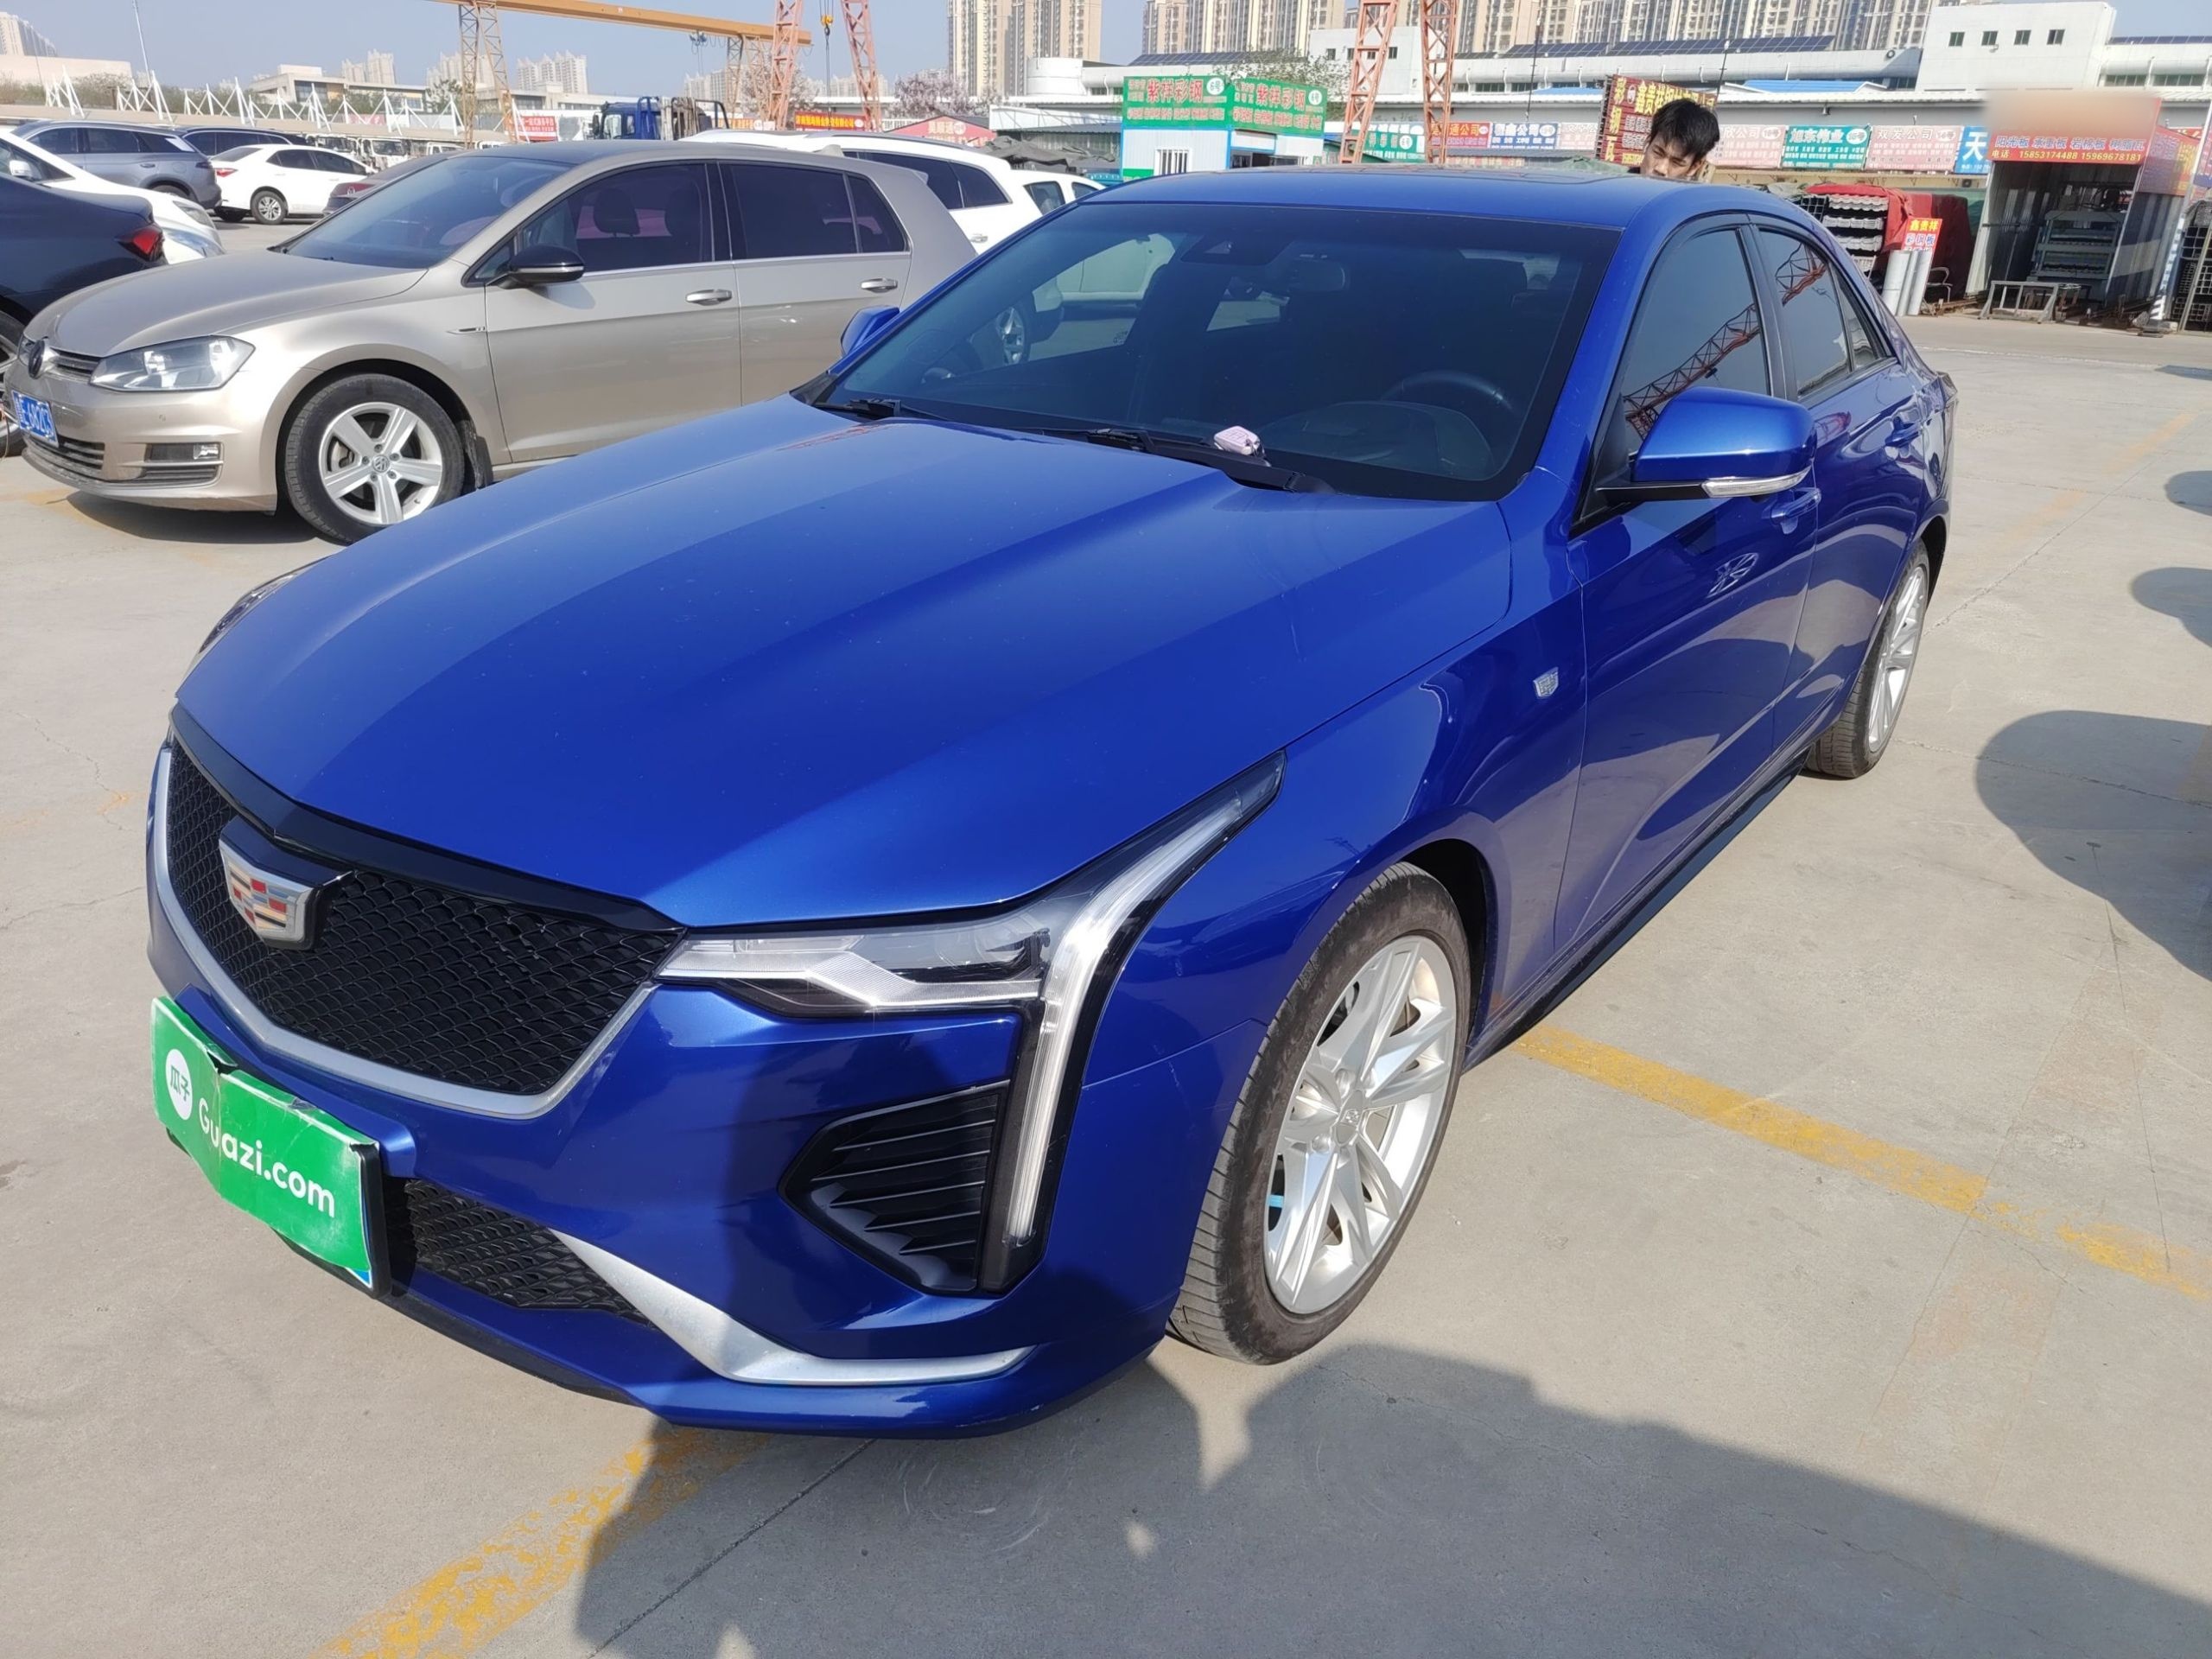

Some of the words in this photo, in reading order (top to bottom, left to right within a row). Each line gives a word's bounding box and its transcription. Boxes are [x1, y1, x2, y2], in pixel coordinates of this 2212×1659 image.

[1992, 149, 2010, 159] 电话
[170, 1065, 191, 1103] 瓜子
[198, 1096, 335, 1218] Guazi.com
